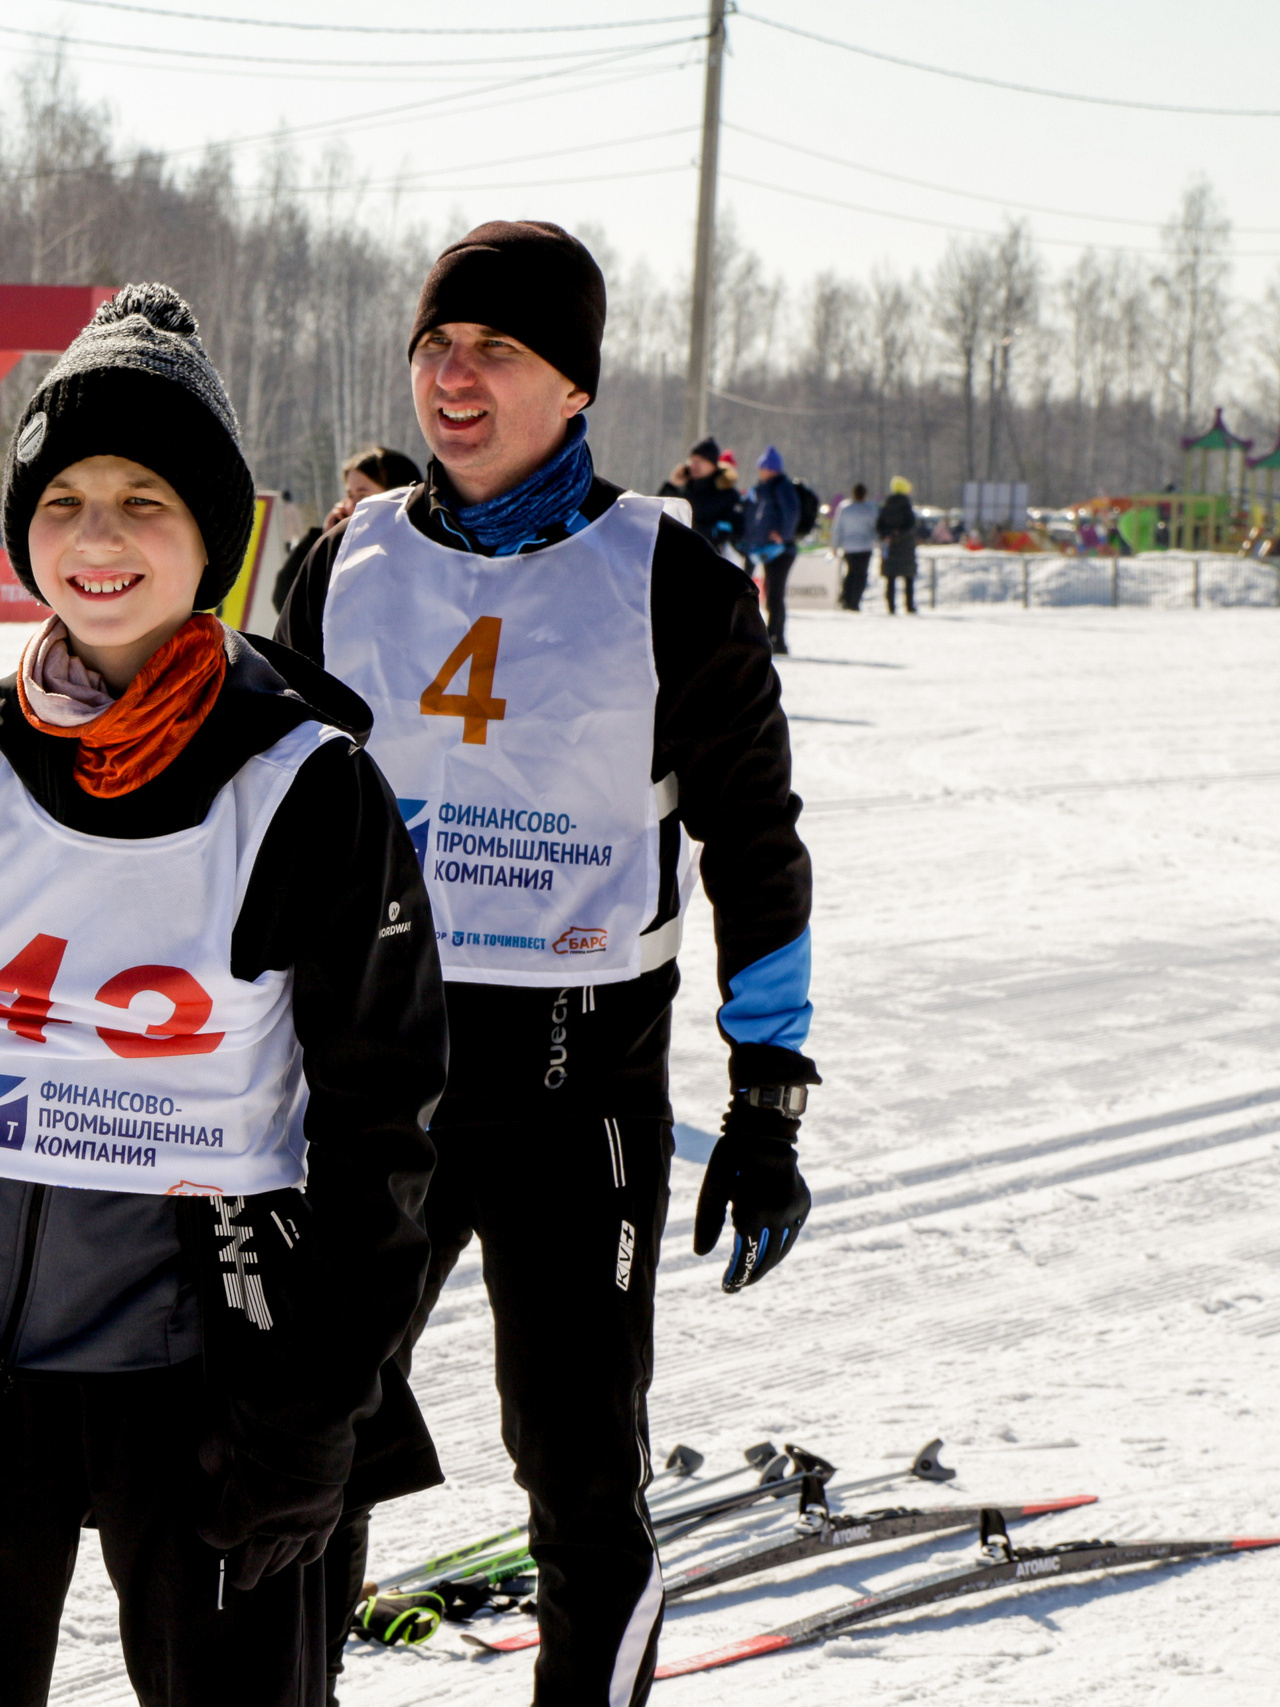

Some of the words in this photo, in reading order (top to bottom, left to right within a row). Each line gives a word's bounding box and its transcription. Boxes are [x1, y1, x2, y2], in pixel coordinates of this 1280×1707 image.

[420, 615, 507, 745] 4
[438, 801, 578, 837] ФИНАНСОВО-
[436, 830, 612, 867] ПРОМЫШЛЕННАЯ
[434, 859, 554, 892] КОМПАНИЯ
[466, 932, 480, 944] ГК
[483, 934, 546, 950] ТОЧИНВЕСТ
[568, 935, 607, 950] БАРС
[39, 1079, 183, 1117] ФИНАНСОВО-
[37, 1107, 225, 1147] ПРОМЫШЛЕННАЯ
[34, 1134, 157, 1168] КОМПАНИЯ
[832, 1525, 871, 1545] ATOMIC
[1016, 1555, 1060, 1577] ATOMIC
